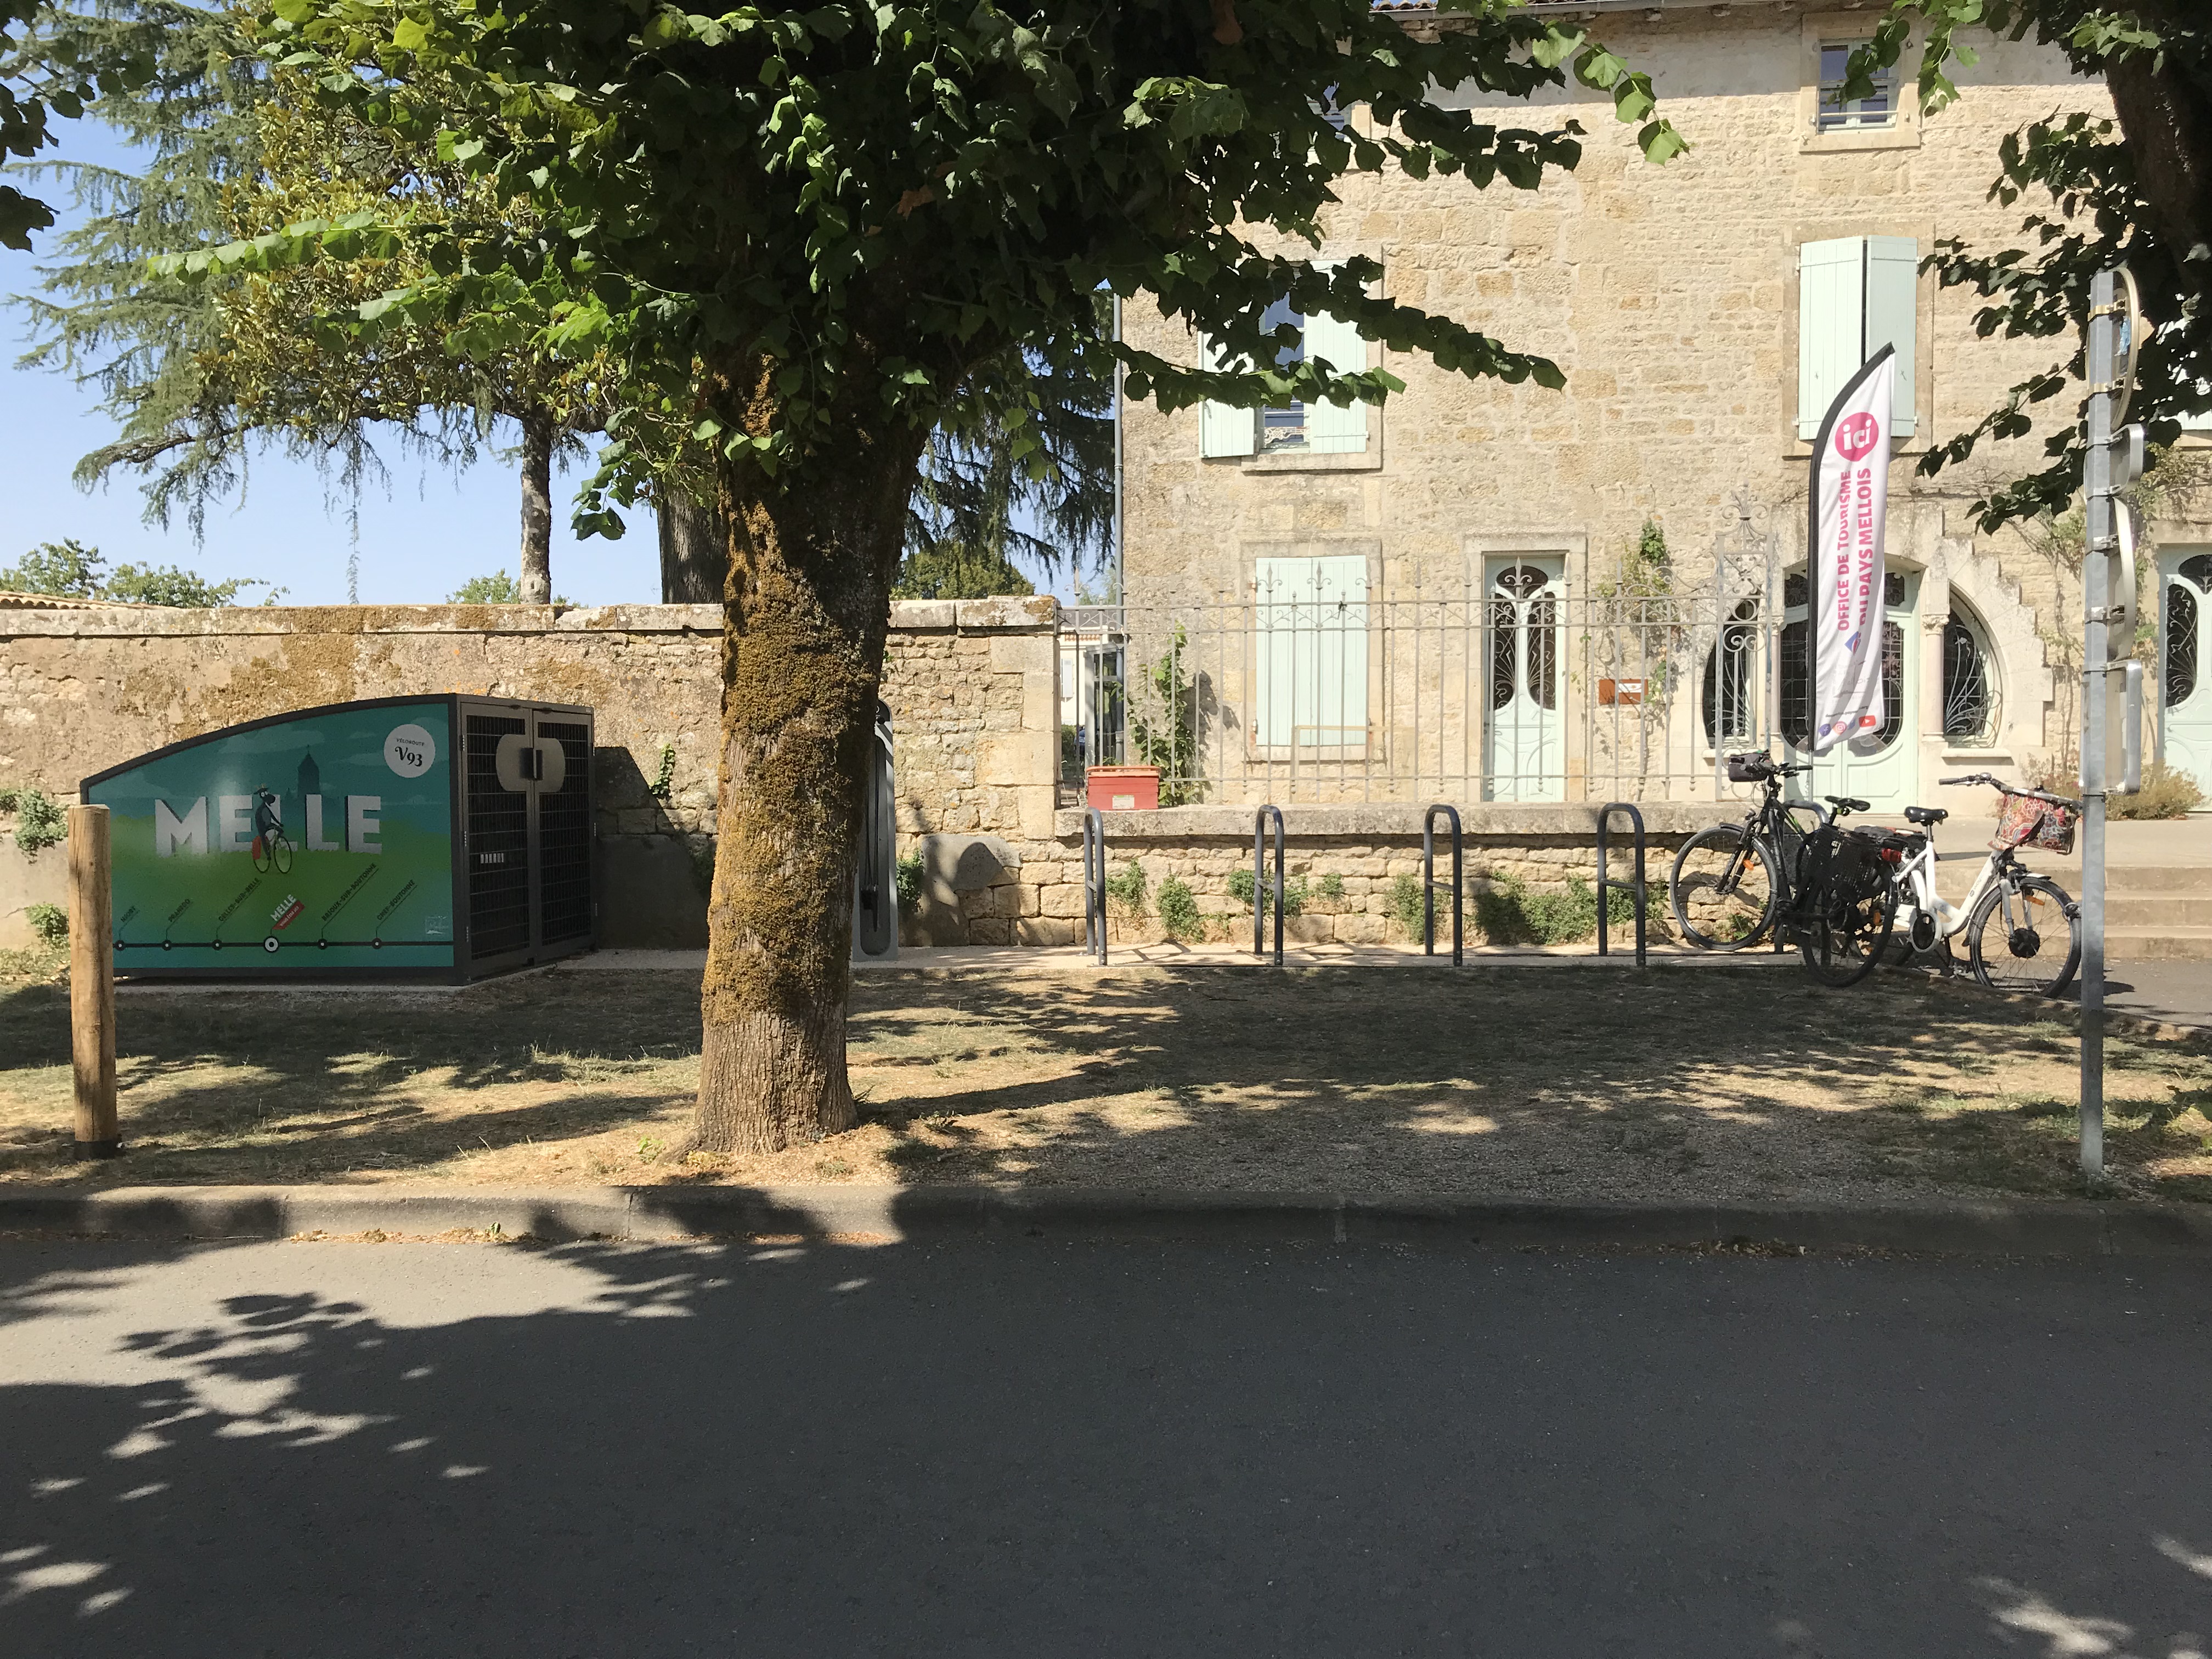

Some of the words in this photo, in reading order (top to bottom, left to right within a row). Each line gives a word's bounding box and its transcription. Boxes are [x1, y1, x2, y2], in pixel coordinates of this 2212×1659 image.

[1843, 419, 1872, 450] ici
[1837, 470, 1852, 551] TOURISME
[1857, 467, 1873, 545] MELLOIS
[1837, 554, 1849, 575] DE
[1858, 548, 1873, 596] PAYS
[1837, 579, 1849, 631] OFFICE
[1859, 600, 1869, 626] DU
[394, 746, 423, 767] V93
[396, 737, 425, 747] VÉLOROUTE
[270, 894, 296, 922] MELLE
